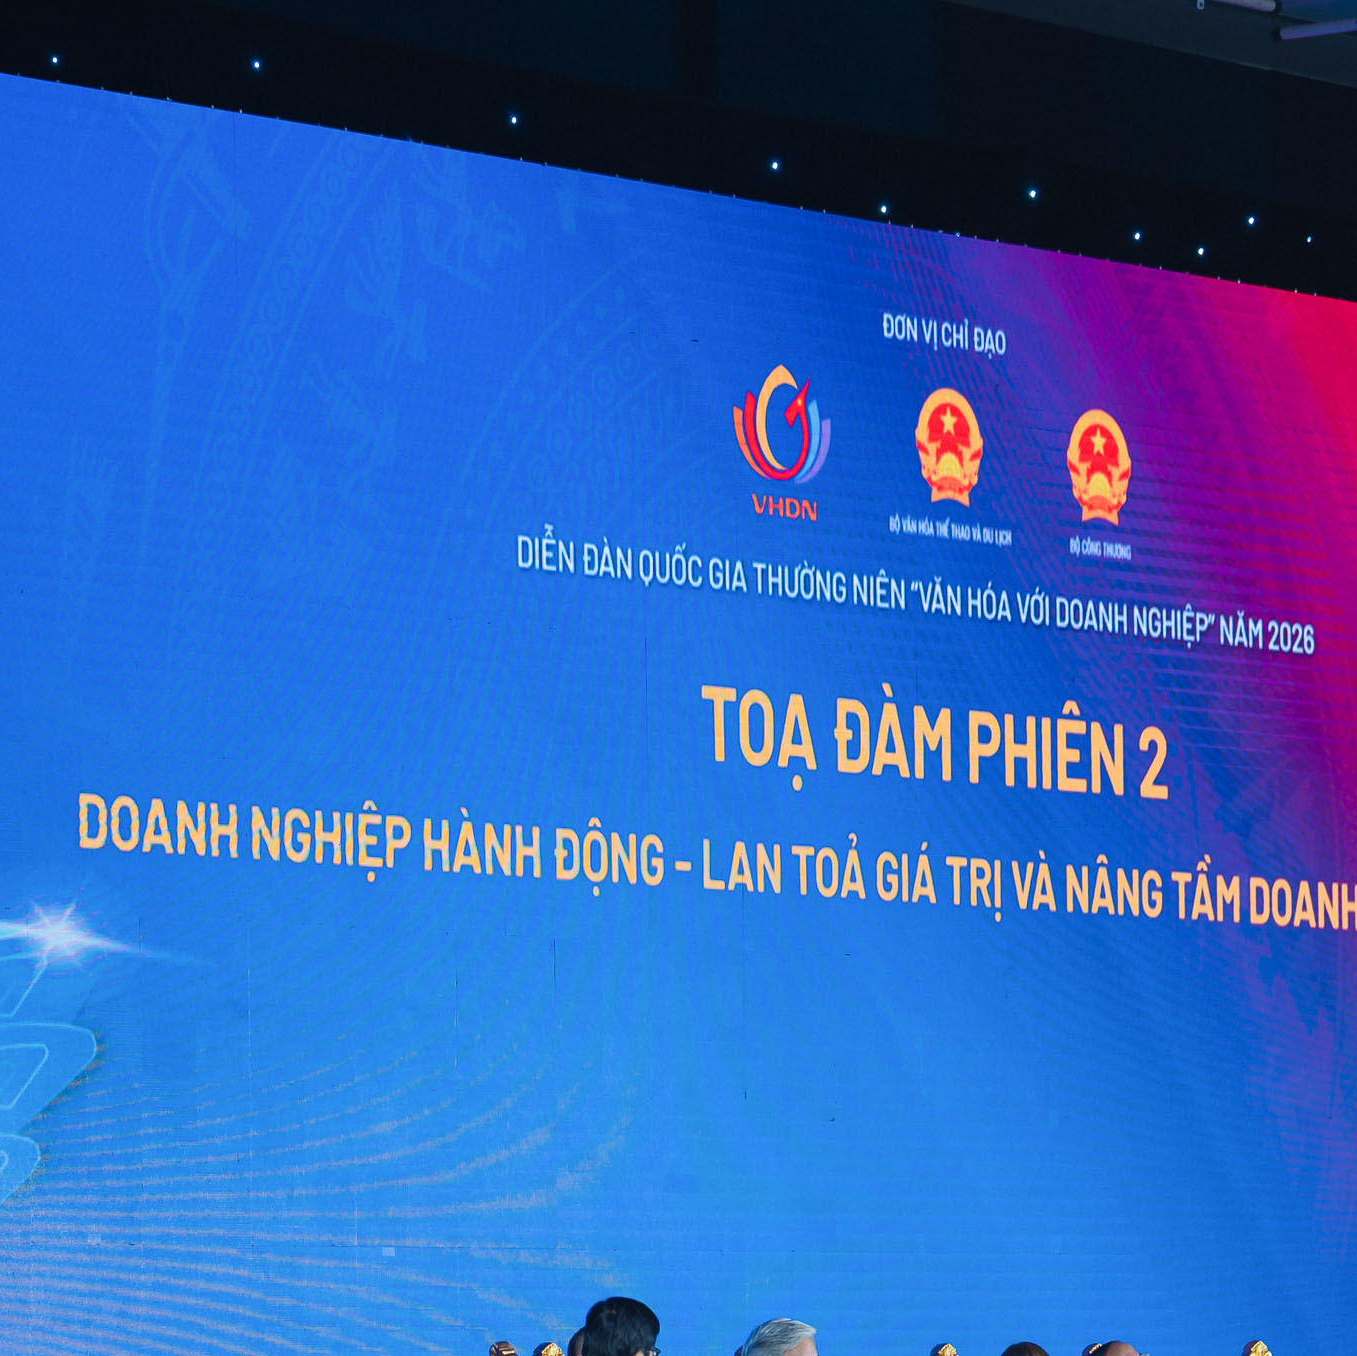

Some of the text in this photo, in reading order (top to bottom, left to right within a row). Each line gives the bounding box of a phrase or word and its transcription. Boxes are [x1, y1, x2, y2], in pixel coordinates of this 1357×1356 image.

[882, 312, 1006, 359] ĐƠN VỊ CHỈ ĐẠO
[751, 493, 817, 522] VHDN
[517, 524, 575, 574] DIỄN
[583, 536, 632, 580] ĐÀN
[639, 543, 702, 588] QUỐC
[709, 557, 747, 593] GIA
[752, 561, 847, 604] THƯỜNG
[852, 568, 906, 610] NIÊN
[967, 580, 1012, 623] HÓA
[1016, 586, 1050, 627] VỚI
[1055, 597, 1128, 635] DOANH
[1219, 610, 1263, 650] NĂM
[1268, 620, 1315, 656] 2026
[701, 682, 1170, 800] TOẠ ĐÀM PHIÊN 2
[79, 792, 240, 859] DOANH
[251, 800, 412, 883] NGHIỆP
[423, 807, 542, 879] HÀNH
[554, 817, 665, 897] ĐỘNG
[702, 838, 782, 895] LAN
[791, 832, 866, 900] TOẢ
[876, 841, 938, 905] GIÁ
[945, 856, 1003, 923] TRỊ
[1011, 849, 1057, 913] VÀ
[1066, 854, 1164, 919] NÂNG
[1171, 854, 1241, 924] TẦM
